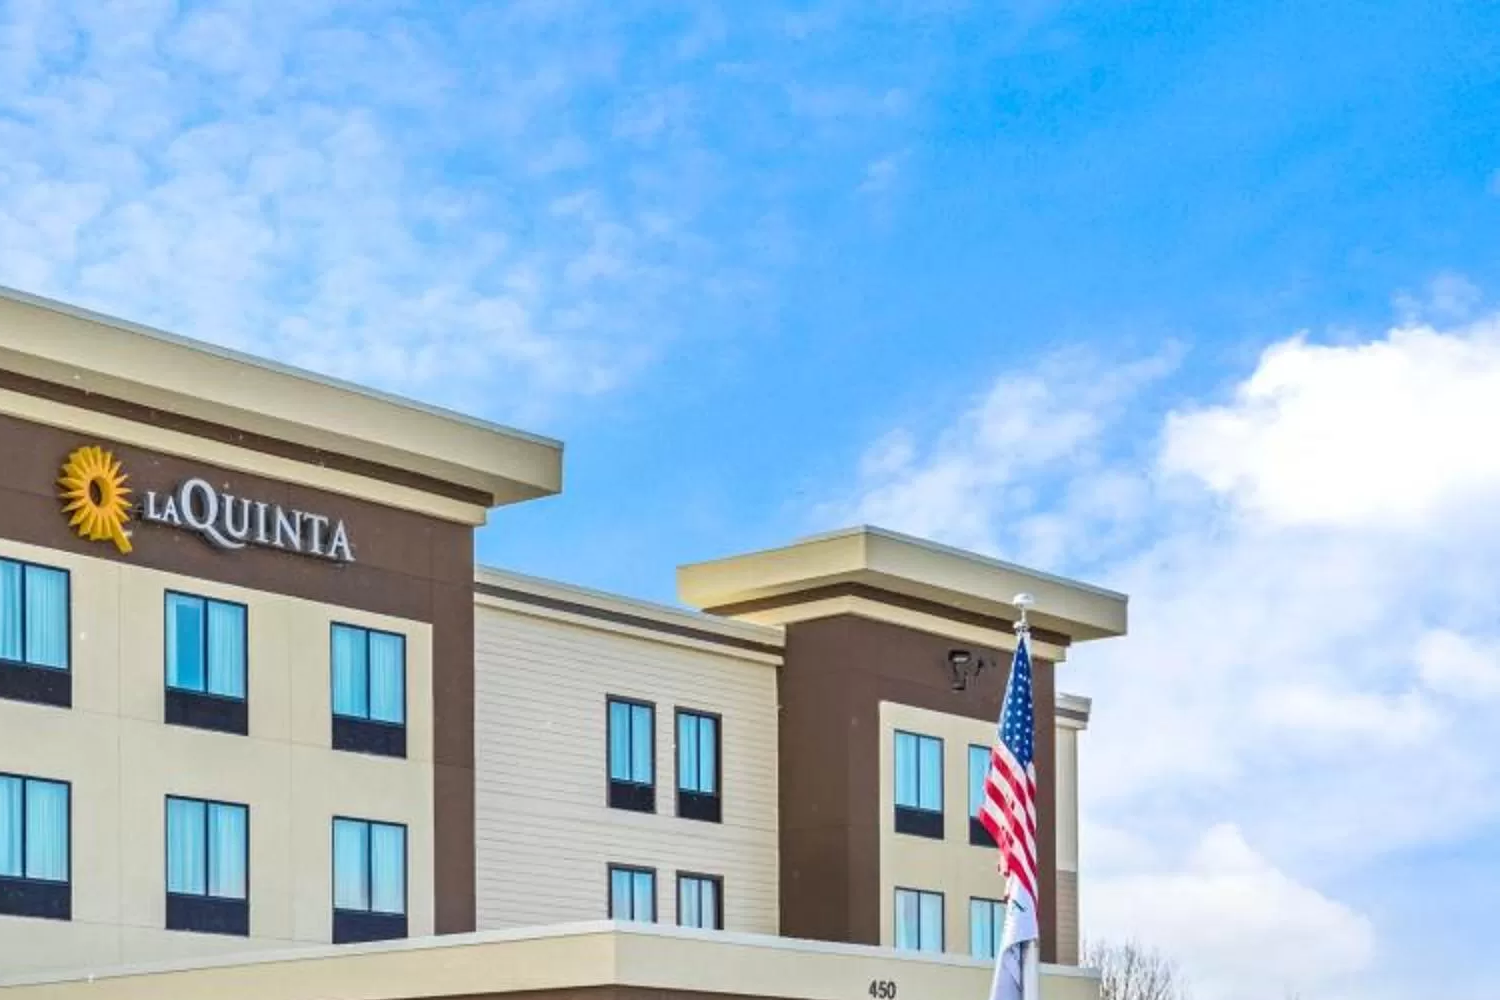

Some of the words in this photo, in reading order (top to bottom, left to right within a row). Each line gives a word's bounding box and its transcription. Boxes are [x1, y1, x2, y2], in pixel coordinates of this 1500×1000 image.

[147, 491, 181, 525] LA
[181, 478, 356, 562] QUINTA
[868, 979, 897, 1000] 450
